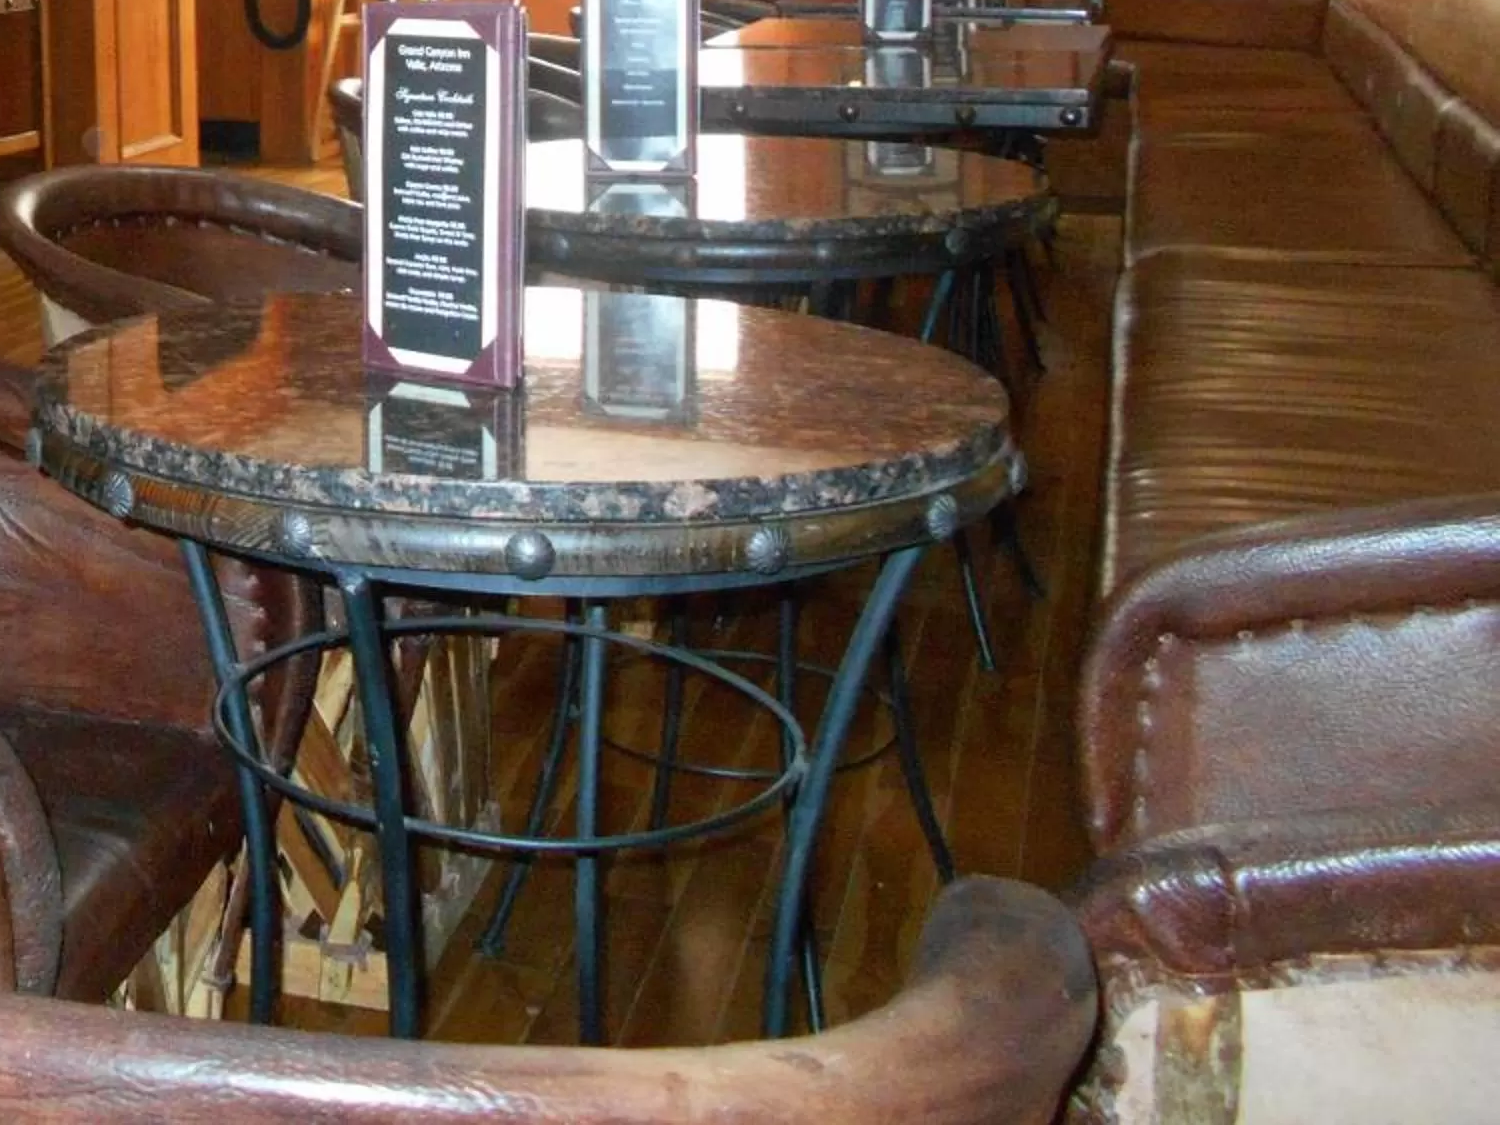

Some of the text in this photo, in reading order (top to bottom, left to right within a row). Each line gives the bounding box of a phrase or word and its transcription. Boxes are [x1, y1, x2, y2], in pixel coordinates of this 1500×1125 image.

[398, 44, 471, 60] Grand Canyon Inn
